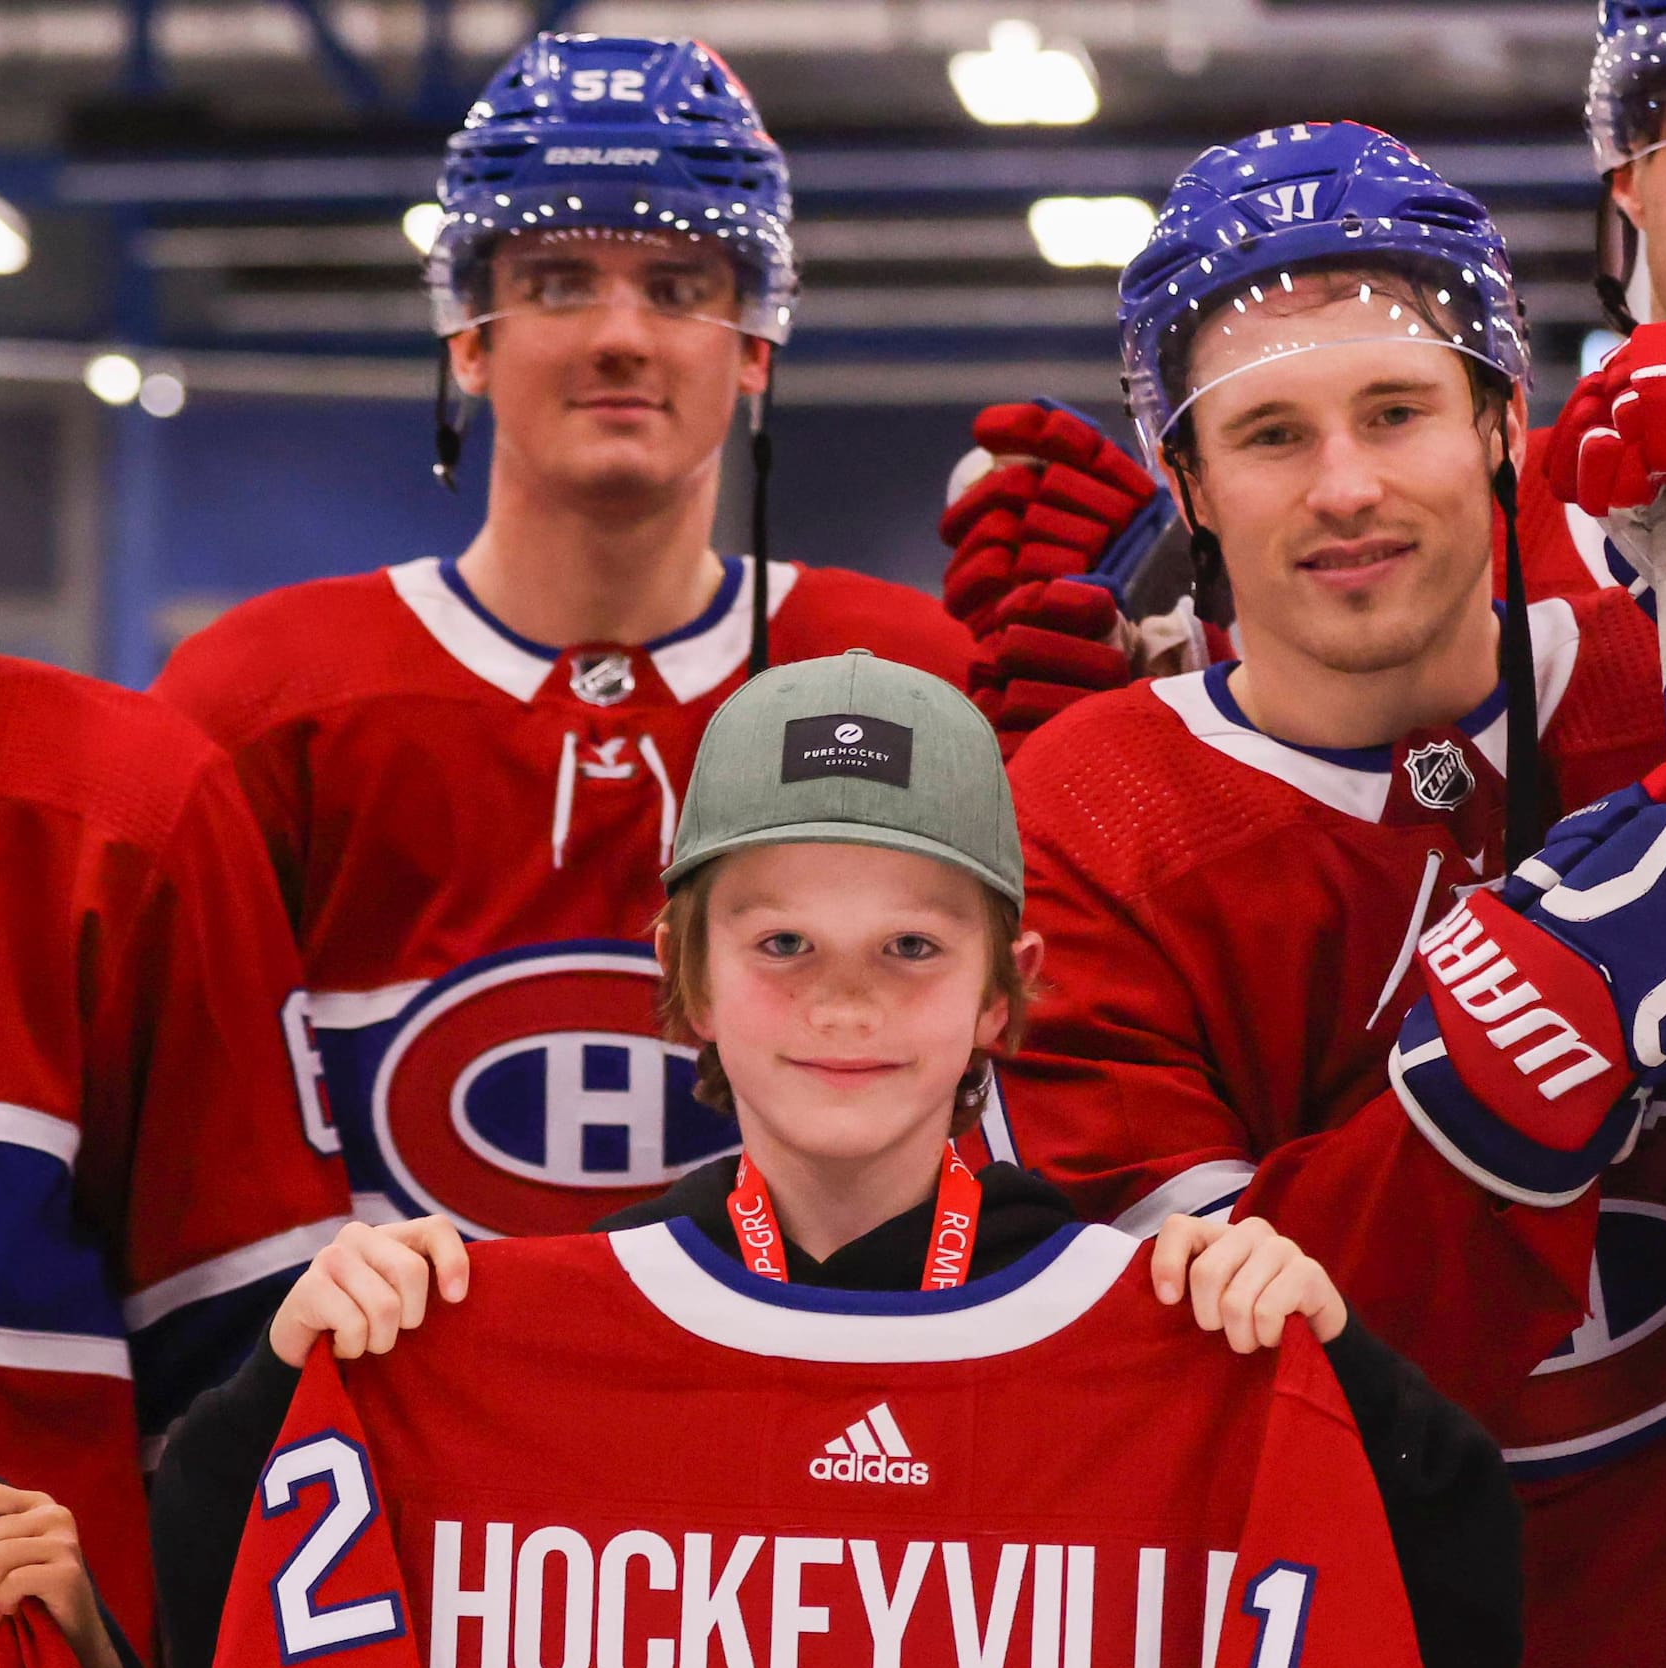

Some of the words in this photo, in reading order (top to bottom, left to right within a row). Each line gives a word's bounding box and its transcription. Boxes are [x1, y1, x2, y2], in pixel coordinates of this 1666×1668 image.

[572, 69, 645, 102] 52
[544, 146, 660, 166] BAUER
[803, 748, 836, 760] PURE
[838, 747, 890, 762] HOCKEY
[809, 1453, 929, 1486] adidas
[258, 1428, 405, 1664] 2
